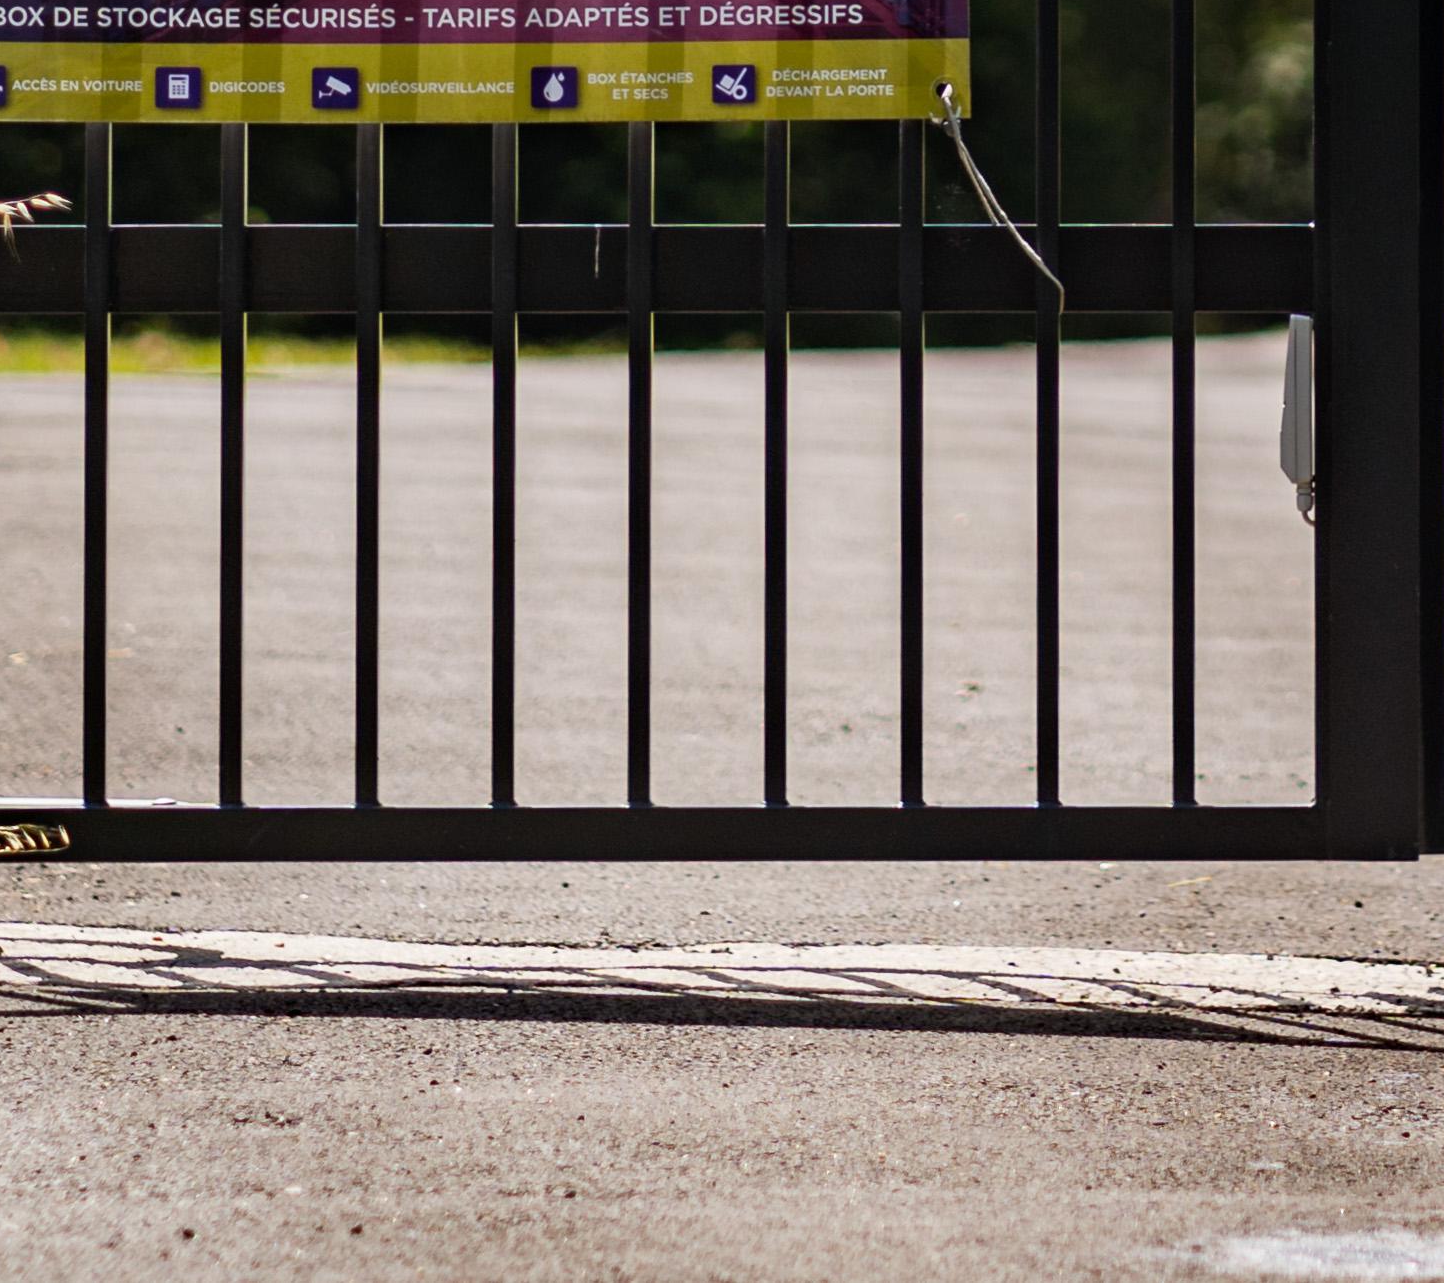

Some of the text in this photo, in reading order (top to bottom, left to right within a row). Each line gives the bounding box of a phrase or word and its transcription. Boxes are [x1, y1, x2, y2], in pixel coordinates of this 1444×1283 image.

[54, 8, 87, 28] DE
[97, 7, 240, 29] STOCKAGE
[249, 3, 396, 28] SÉCURISÉS
[423, 7, 516, 28] TARIFS
[524, 2, 649, 27] ADAPTÉS
[658, 6, 691, 26] ET
[700, 1, 863, 26] DÉGRESSIFS
[587, 69, 693, 84] BOX ÉTANCHES
[772, 67, 887, 82] DÉCHARGEMENT
[60, 80, 79, 91] EN
[83, 79, 144, 91] VOITURE
[209, 81, 285, 94] DIGICODES
[366, 80, 515, 95] VIDÉOSURVEILLANCE
[766, 84, 894, 98] DEVANT LA PORTE
[612, 87, 669, 100] ET SECS
